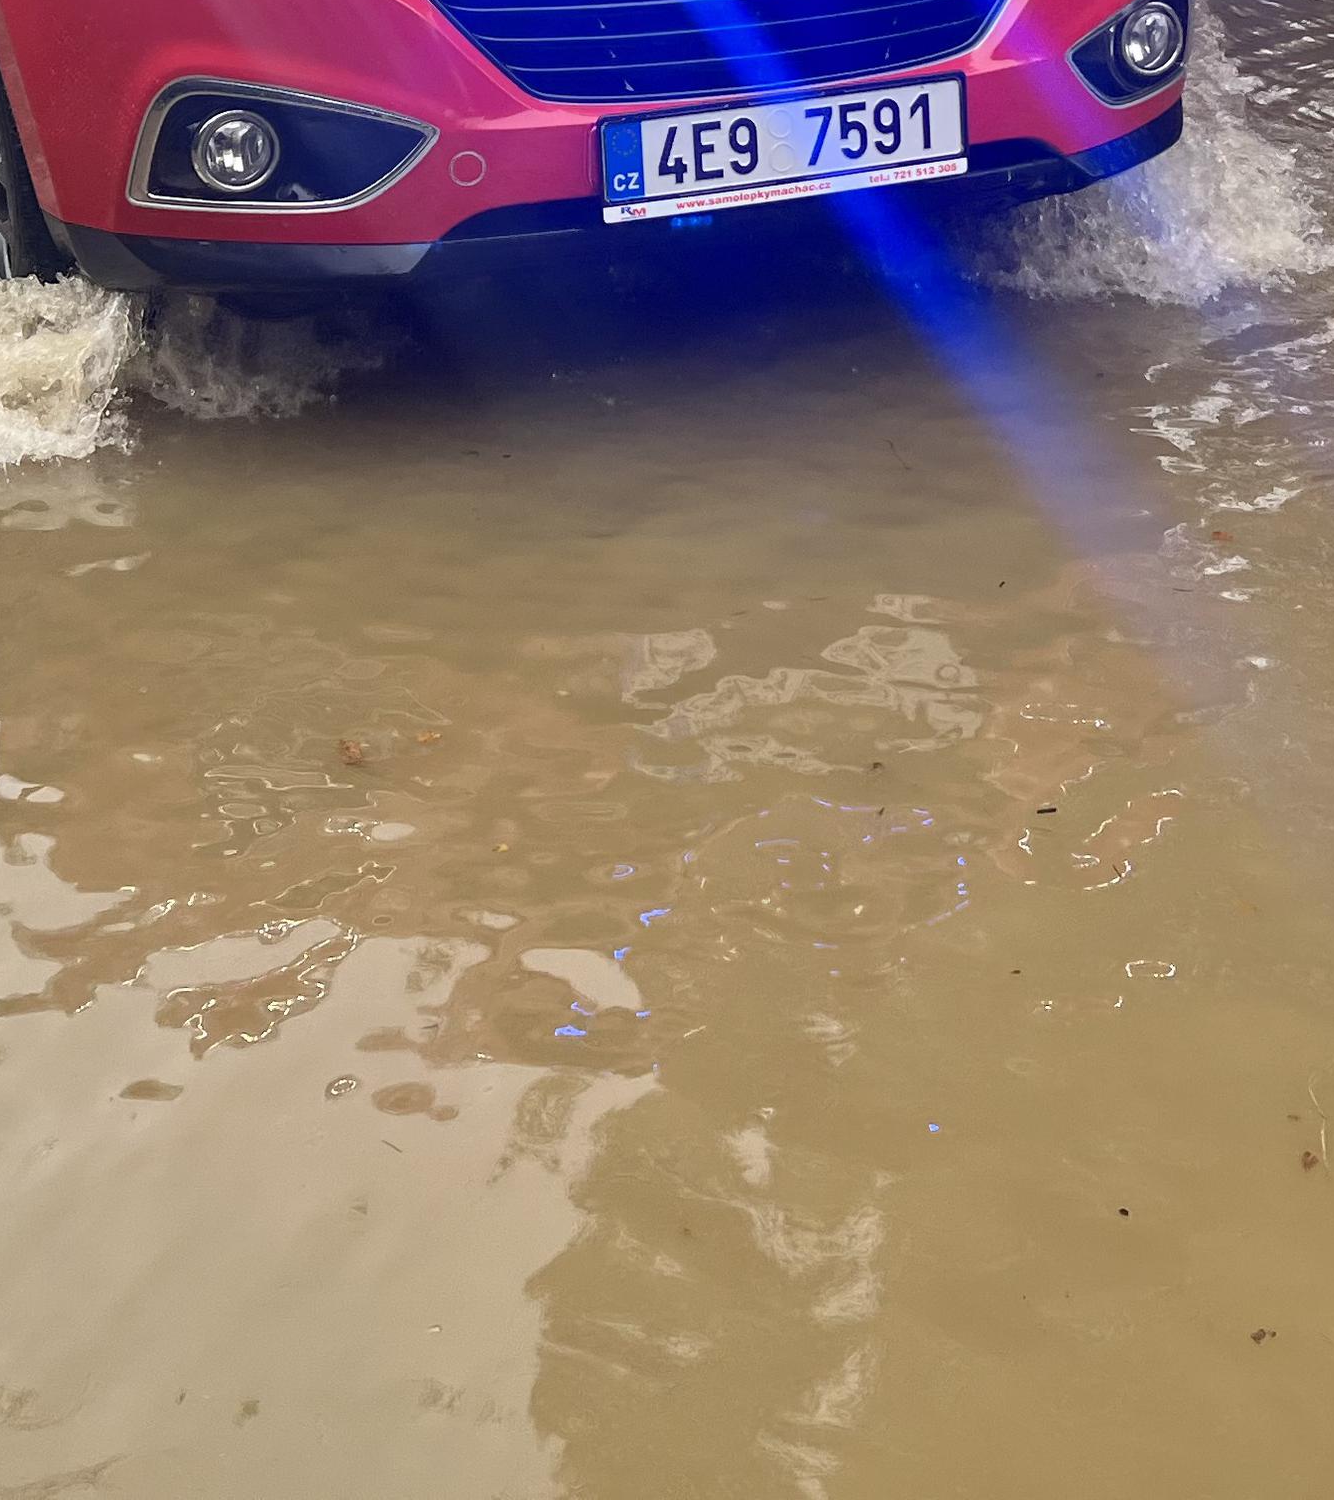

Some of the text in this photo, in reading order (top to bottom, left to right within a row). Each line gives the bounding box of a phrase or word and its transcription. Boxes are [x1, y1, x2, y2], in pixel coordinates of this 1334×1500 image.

[613, 92, 932, 191] CZ 4E9 7591
[893, 169, 912, 180] 721
[916, 166, 935, 177] 512
